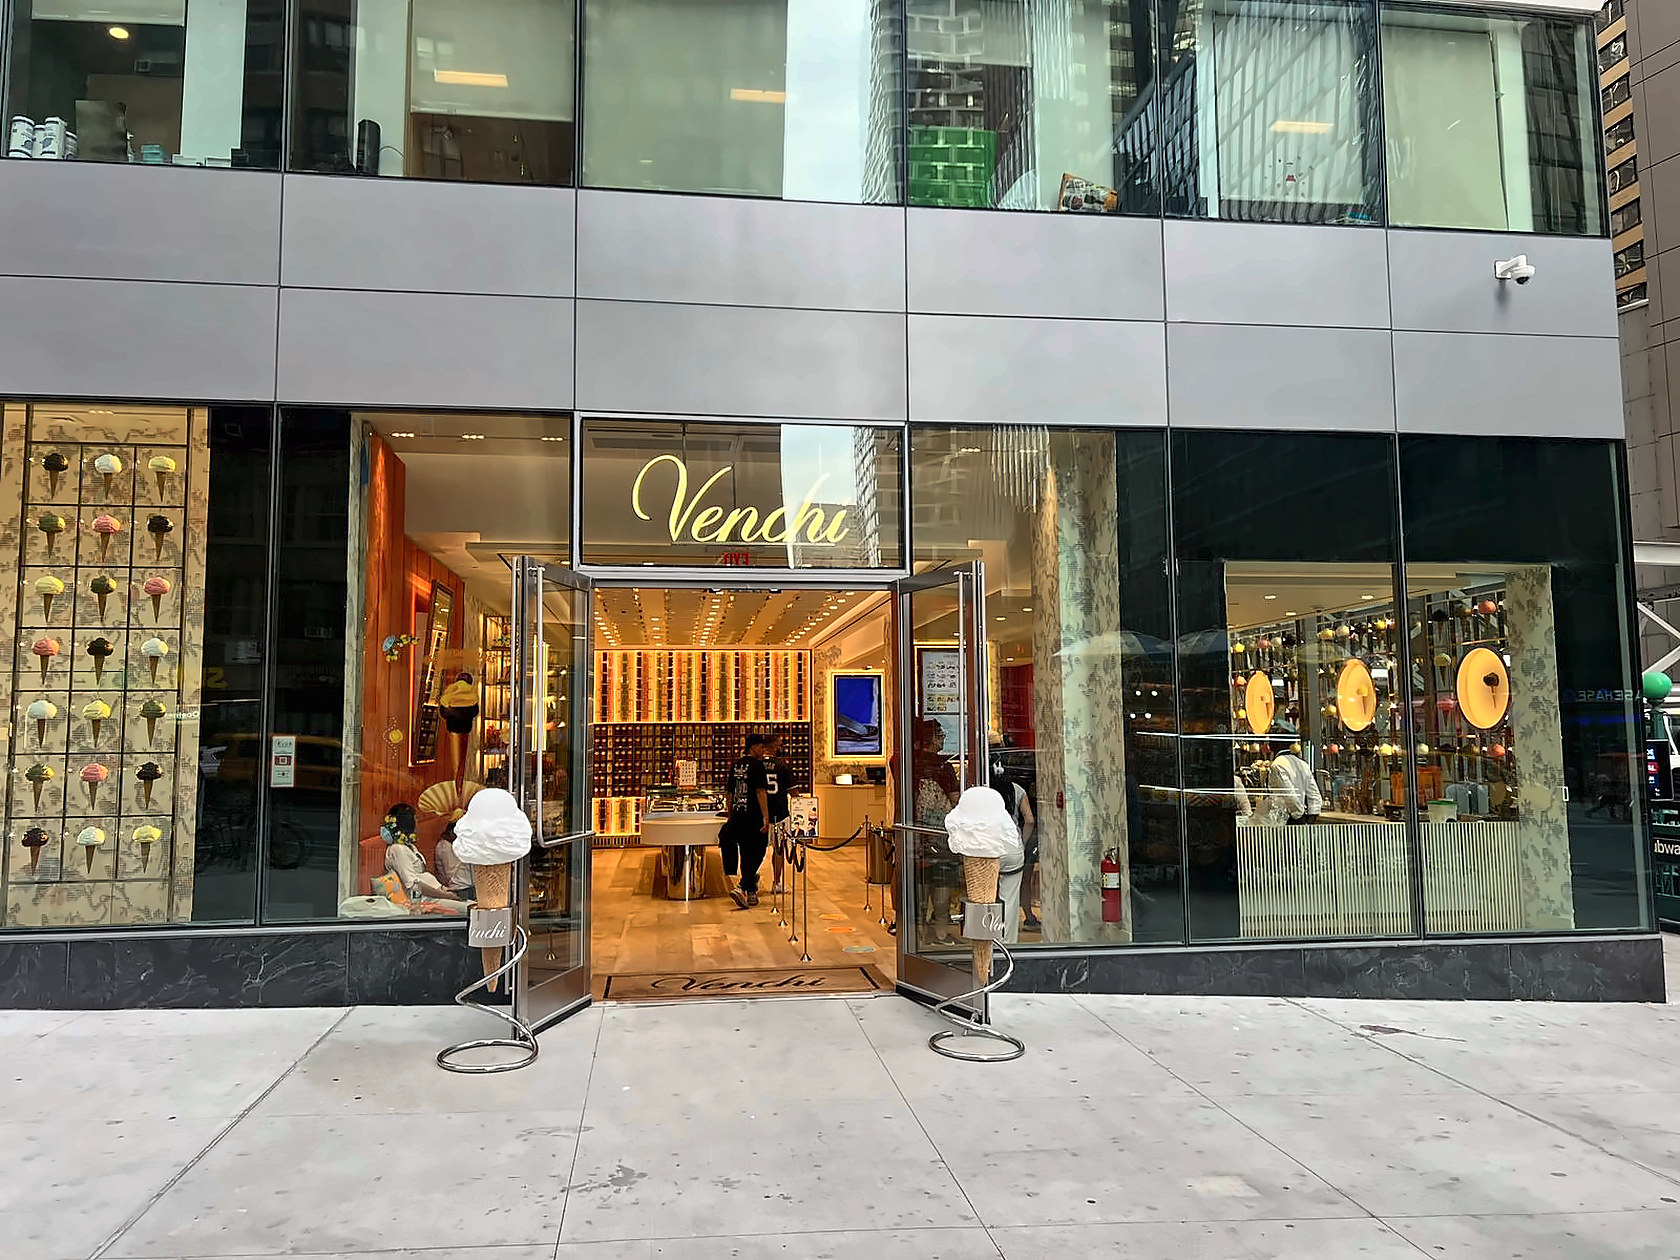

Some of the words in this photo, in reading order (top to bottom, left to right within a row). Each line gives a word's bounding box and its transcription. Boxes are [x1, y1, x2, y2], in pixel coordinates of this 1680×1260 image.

[632, 453, 849, 543] Venchi
[766, 773, 778, 794] 5
[651, 974, 827, 991] Venchi
